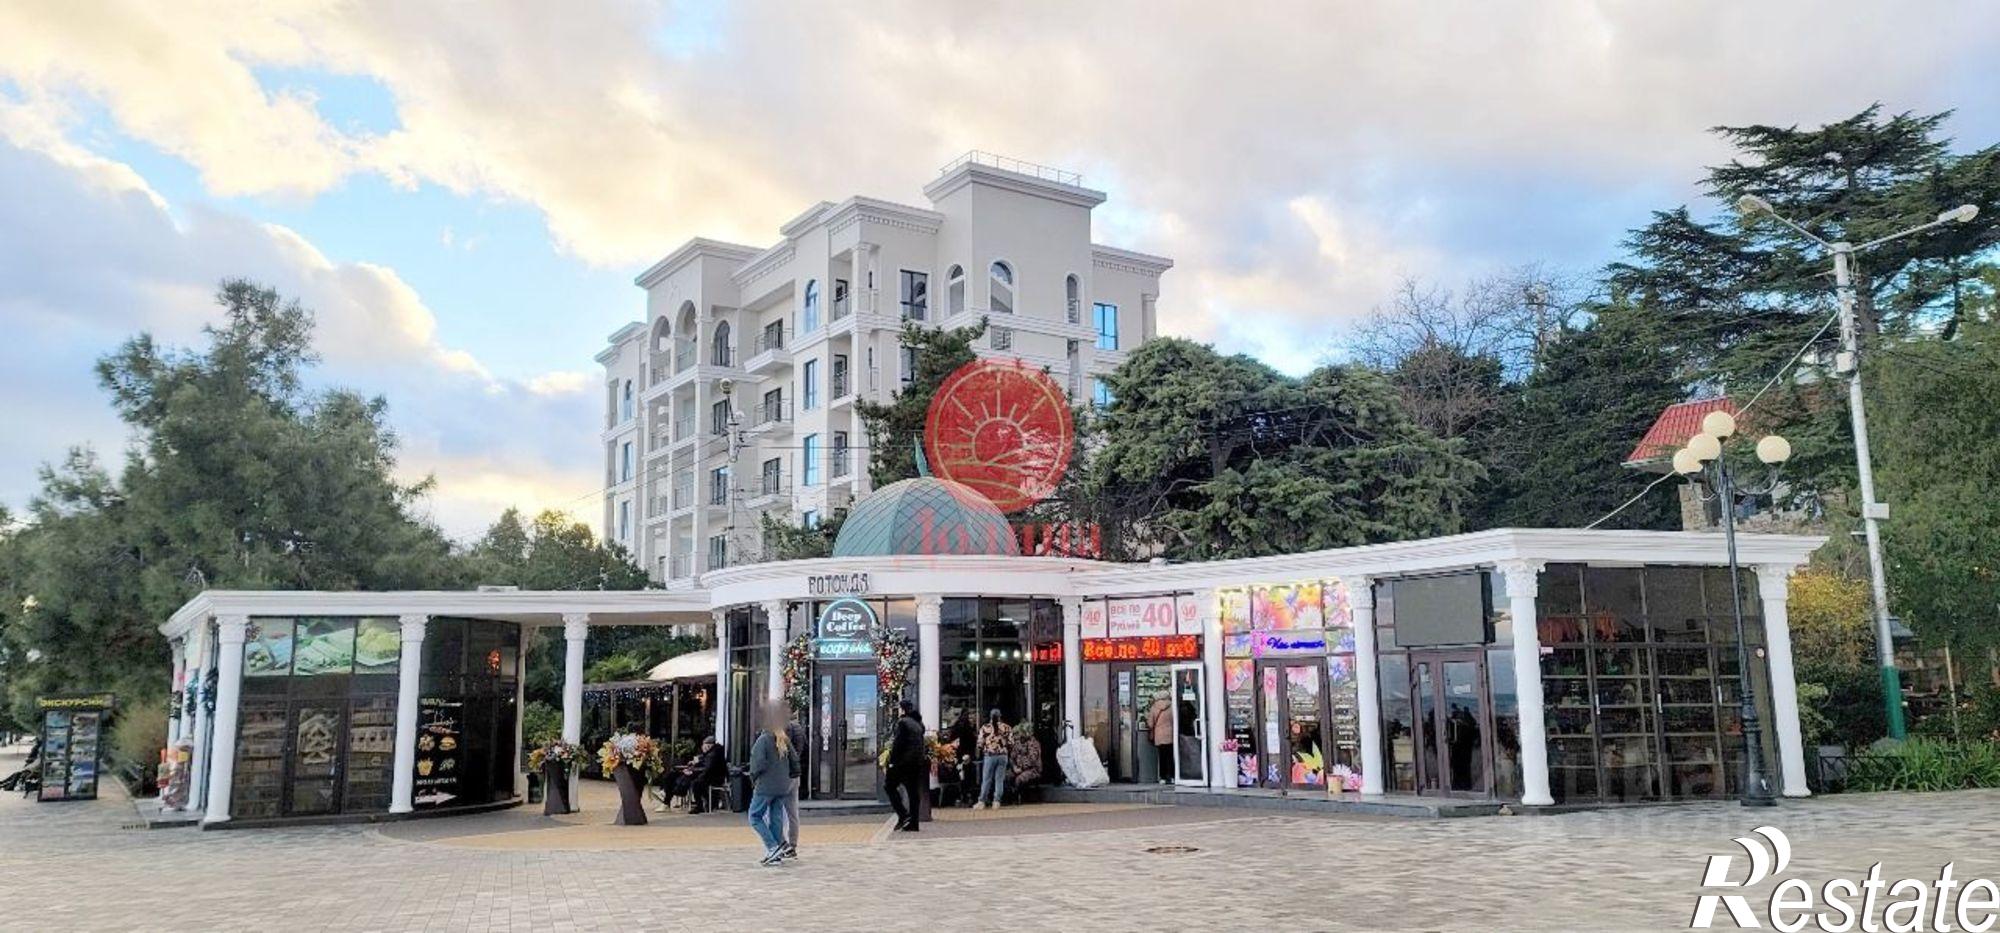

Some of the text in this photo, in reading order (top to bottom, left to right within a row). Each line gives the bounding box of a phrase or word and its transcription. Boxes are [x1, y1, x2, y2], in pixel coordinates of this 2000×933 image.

[808, 573, 869, 594] РОТОНДА
[1142, 603, 1173, 628] 40
[1142, 638, 1161, 655] 40
